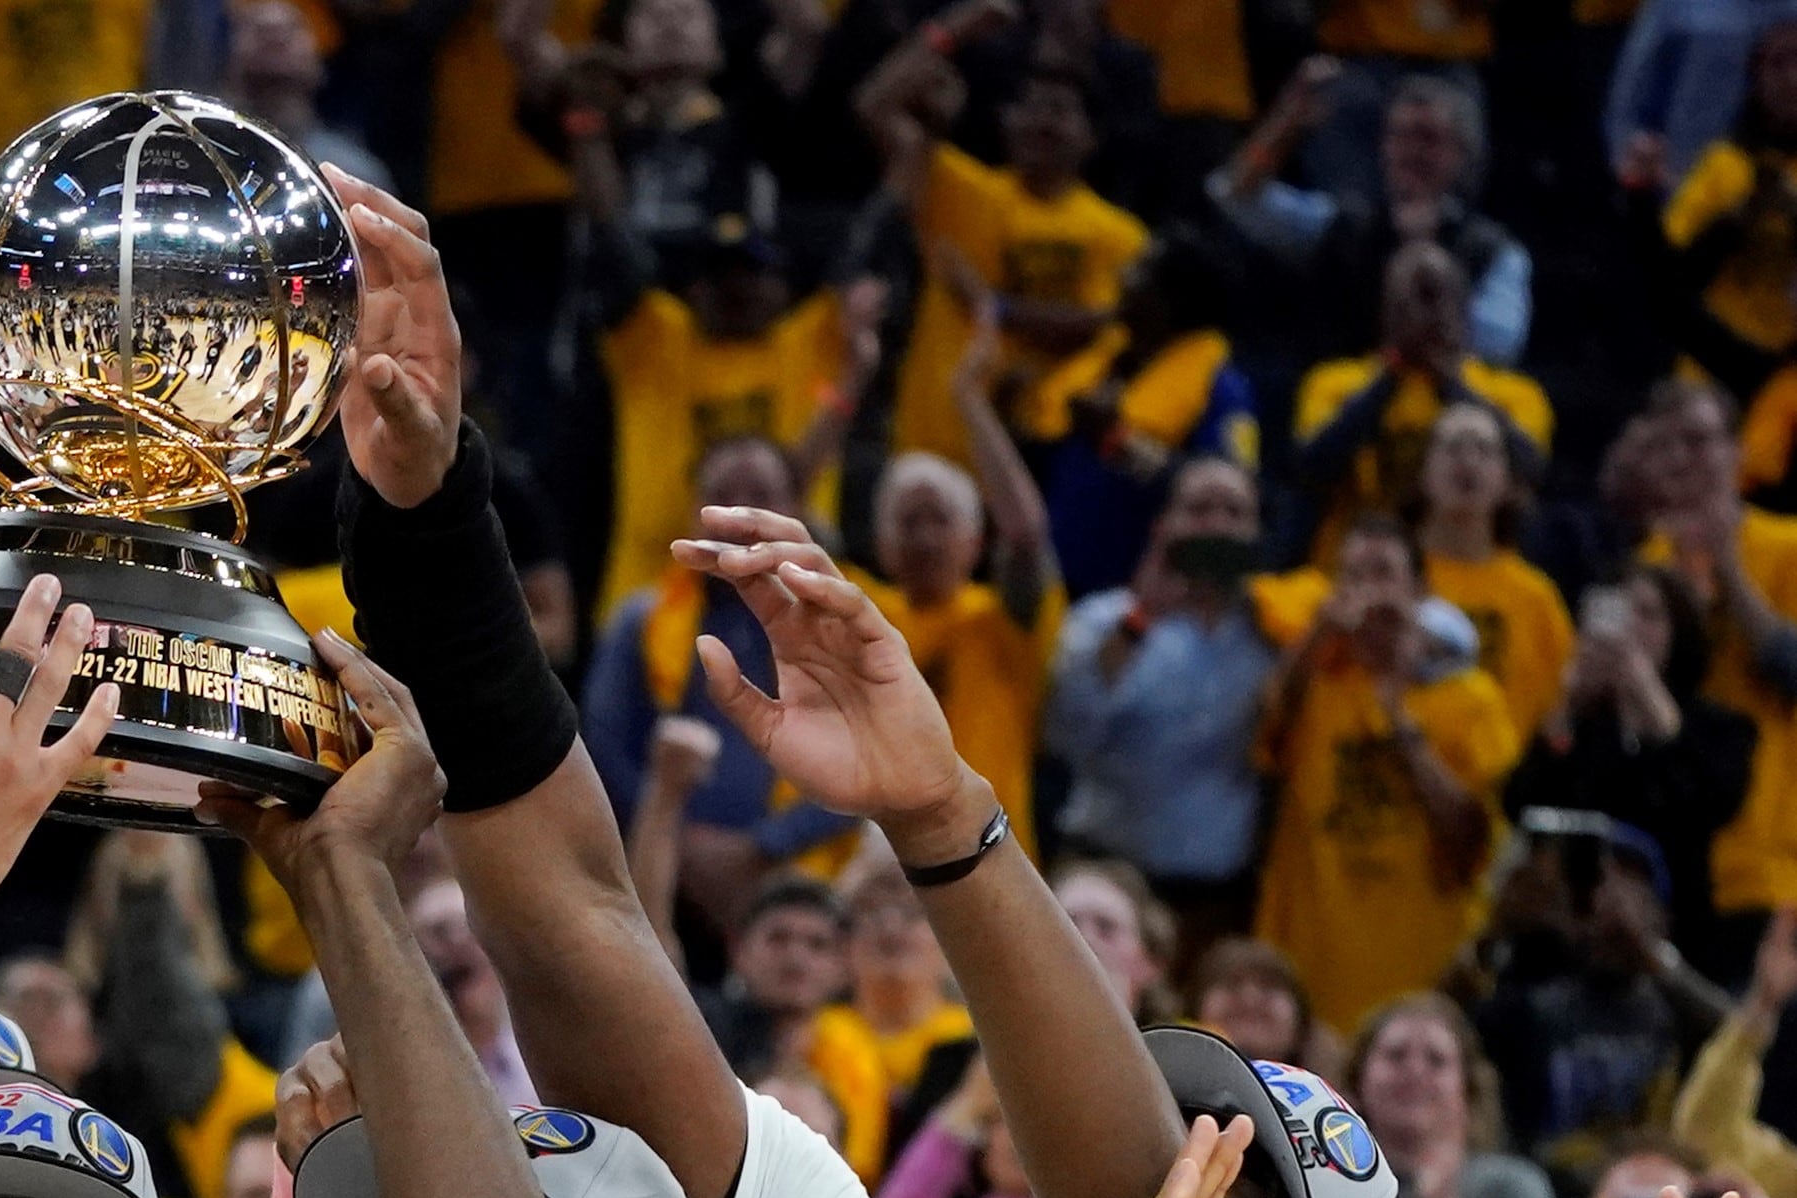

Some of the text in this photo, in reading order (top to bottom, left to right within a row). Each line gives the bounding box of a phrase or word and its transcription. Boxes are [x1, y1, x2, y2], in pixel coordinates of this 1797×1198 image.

[126, 628, 164, 660] THE
[169, 636, 233, 675] OSCAR
[71, 651, 136, 684] 21-22
[142, 657, 181, 693] NBA
[185, 665, 265, 712] WESTERN
